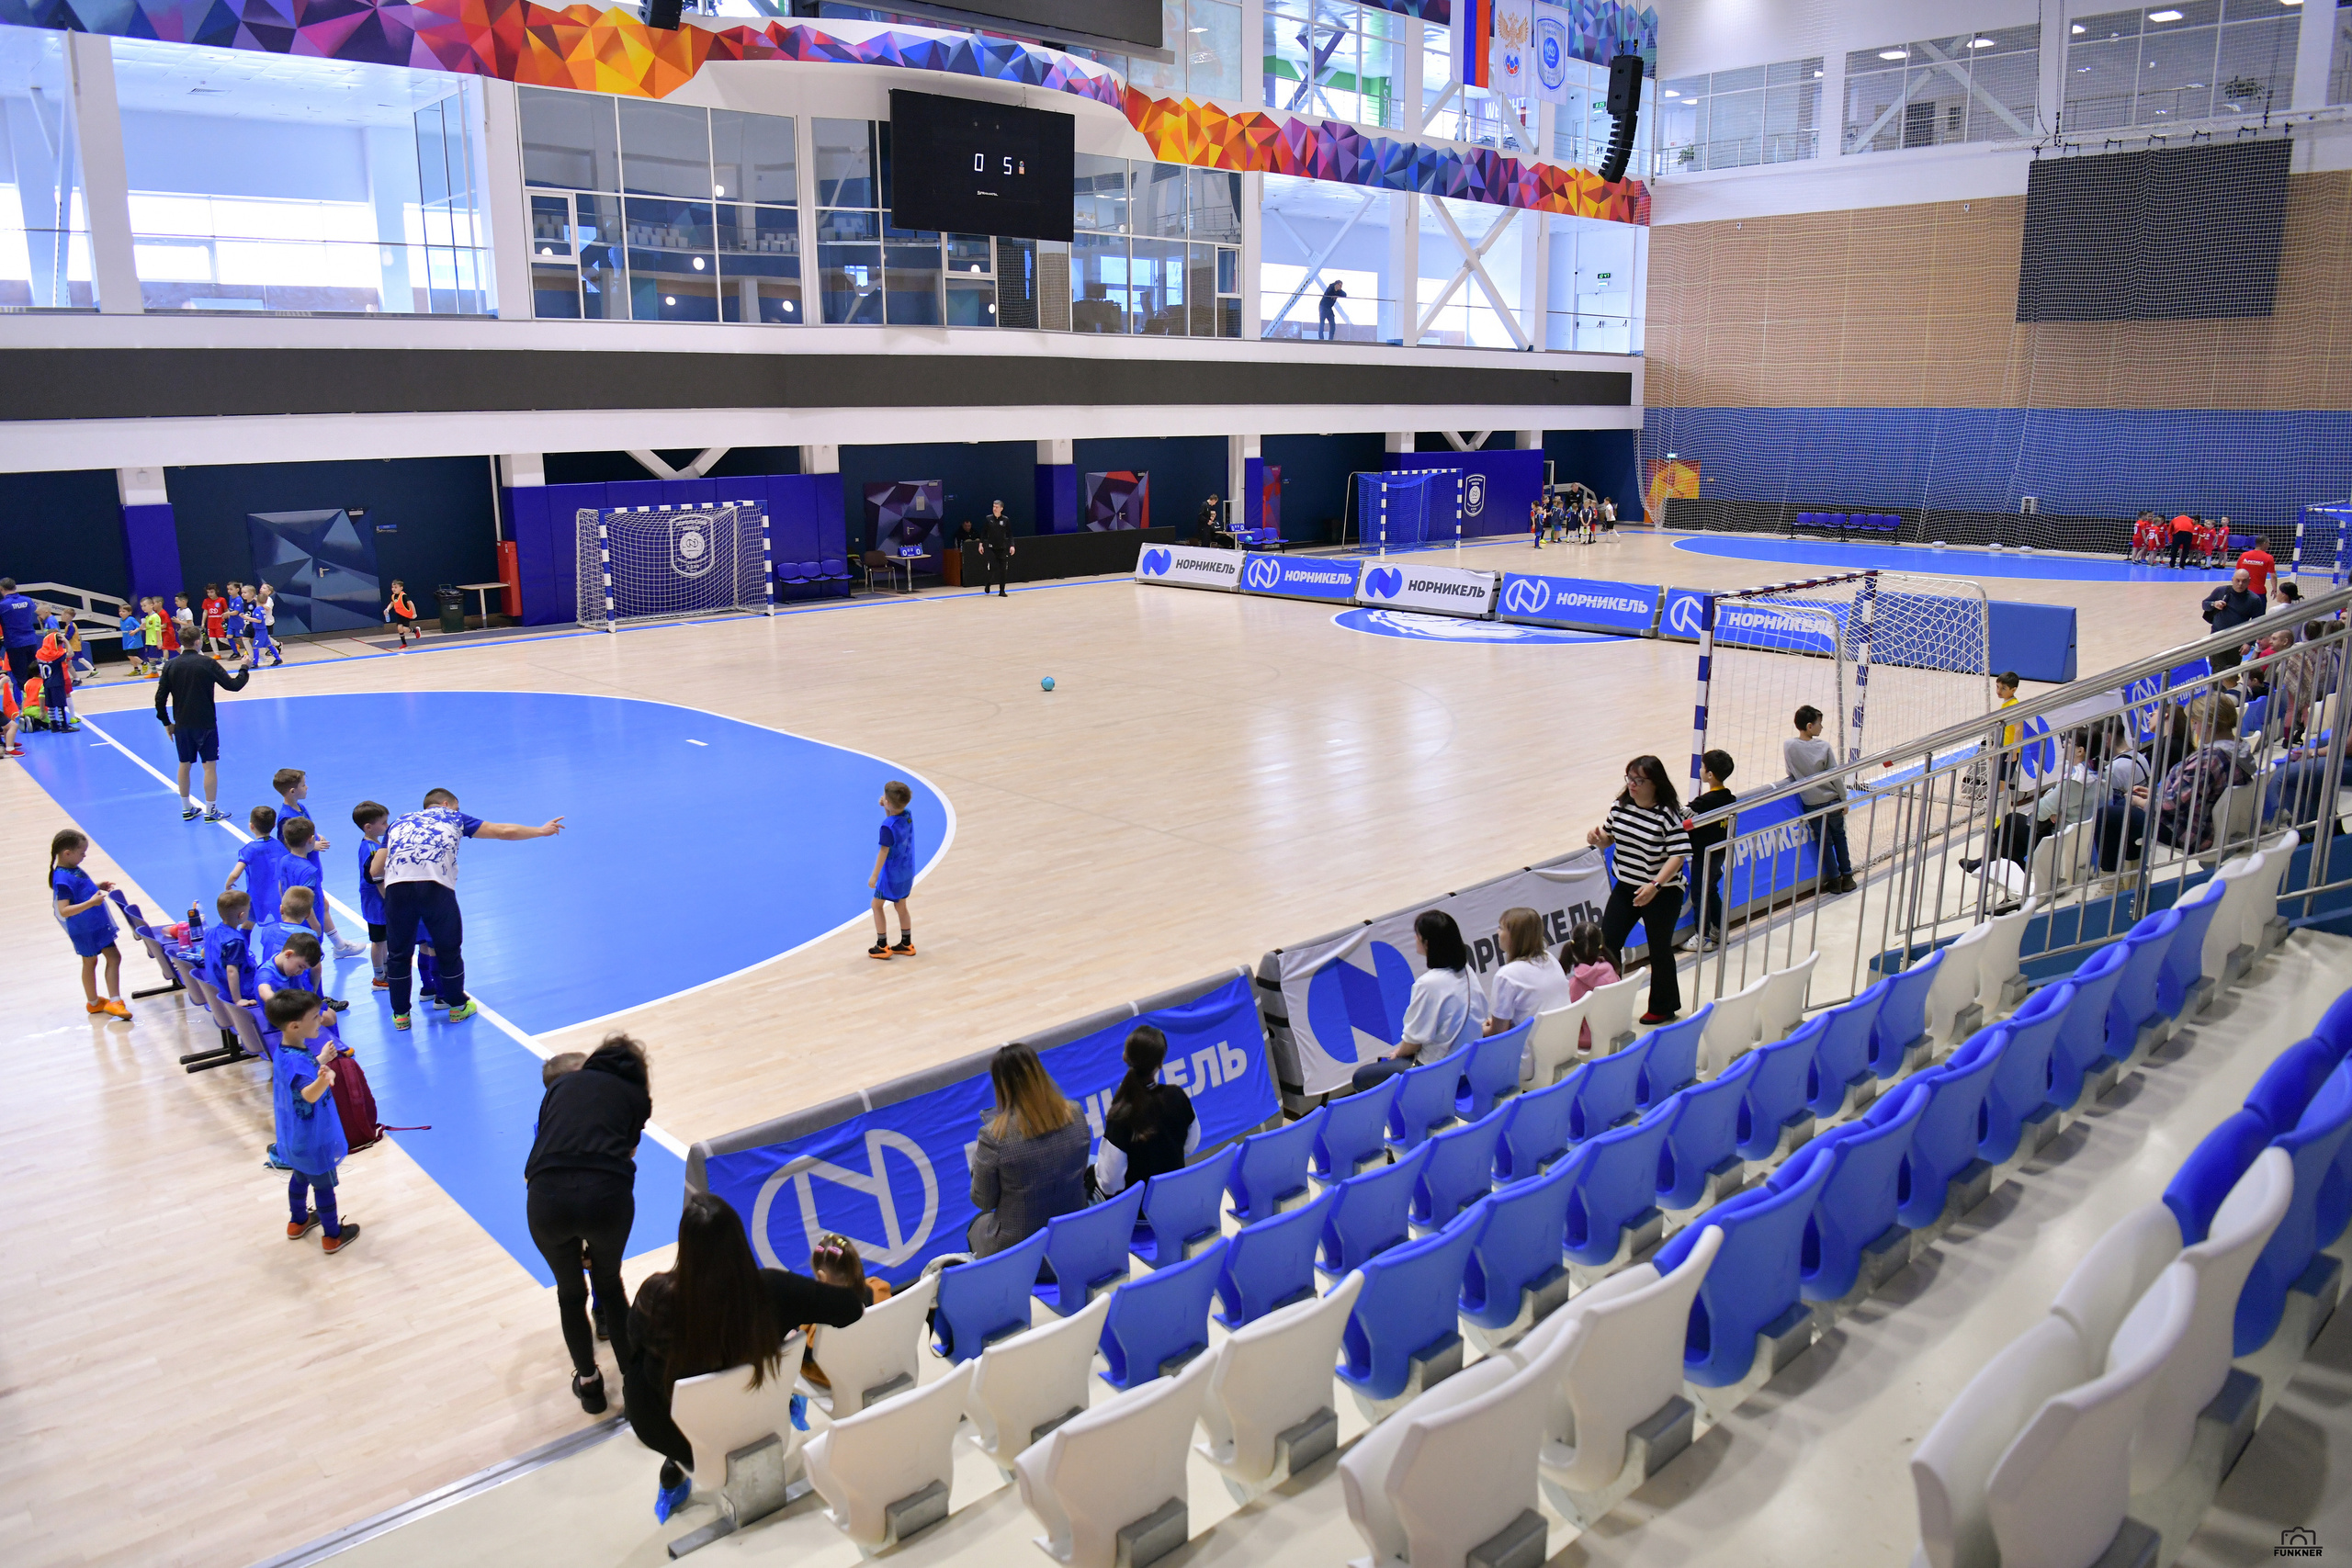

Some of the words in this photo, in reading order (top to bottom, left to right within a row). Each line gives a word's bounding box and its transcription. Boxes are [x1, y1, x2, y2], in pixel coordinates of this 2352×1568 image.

[974, 153, 984, 172] 0
[1003, 156, 1012, 175] 5
[1176, 558, 1235, 575] НОРНИКЕЛЬ
[1284, 570, 1352, 585] НОРНИКЕЛЬ
[1408, 579, 1486, 598] НОРНИКЕЛЬ
[1555, 592, 1649, 614] НОРНИКЕЛЬ
